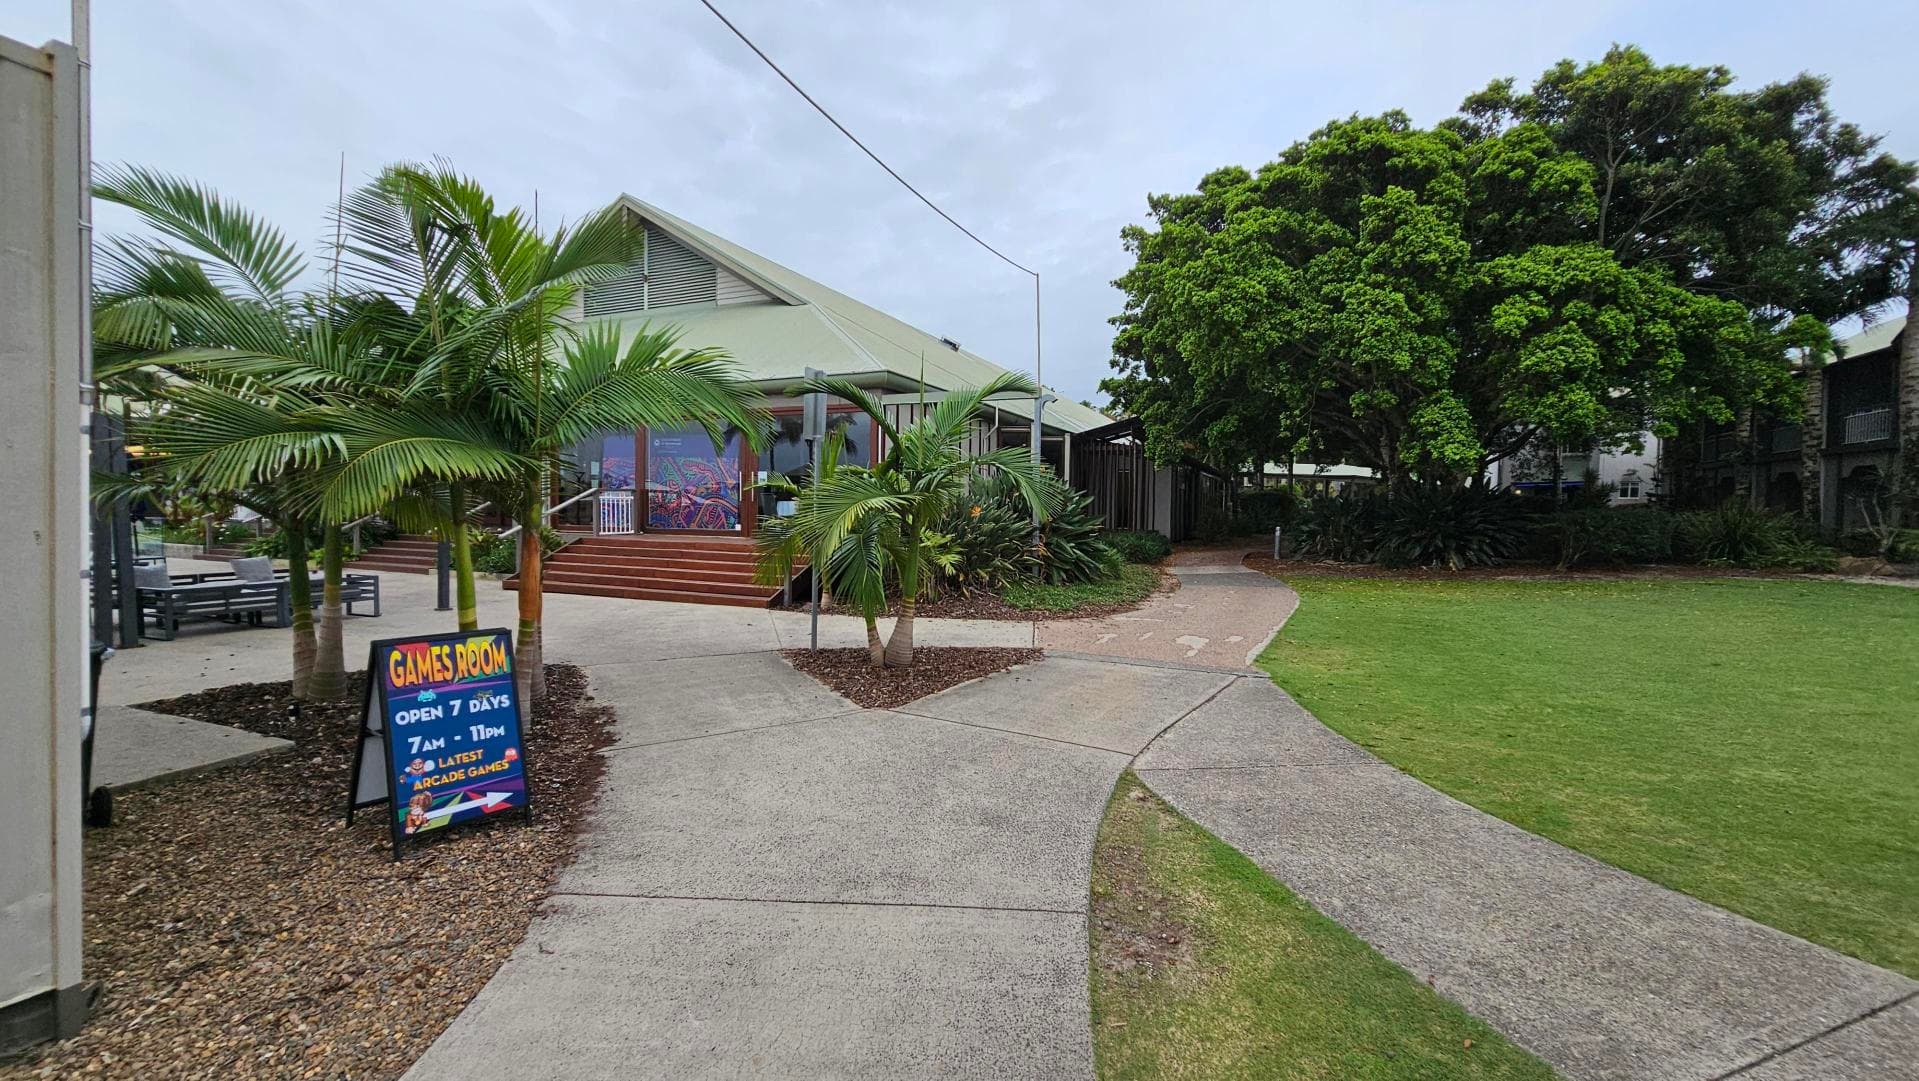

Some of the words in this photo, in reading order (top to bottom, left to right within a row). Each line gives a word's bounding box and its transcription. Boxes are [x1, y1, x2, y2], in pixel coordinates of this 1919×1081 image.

[389, 645, 453, 688] GAMES
[455, 640, 507, 678] ROOM
[395, 705, 443, 725] OPEN
[449, 699, 462, 716] 7
[469, 694, 510, 713] DAYS
[408, 736, 445, 754] 7AM
[469, 724, 504, 741] 11PM
[438, 749, 483, 768] LATEST
[413, 769, 465, 791] ARCADE
[468, 761, 509, 777] GAMES
